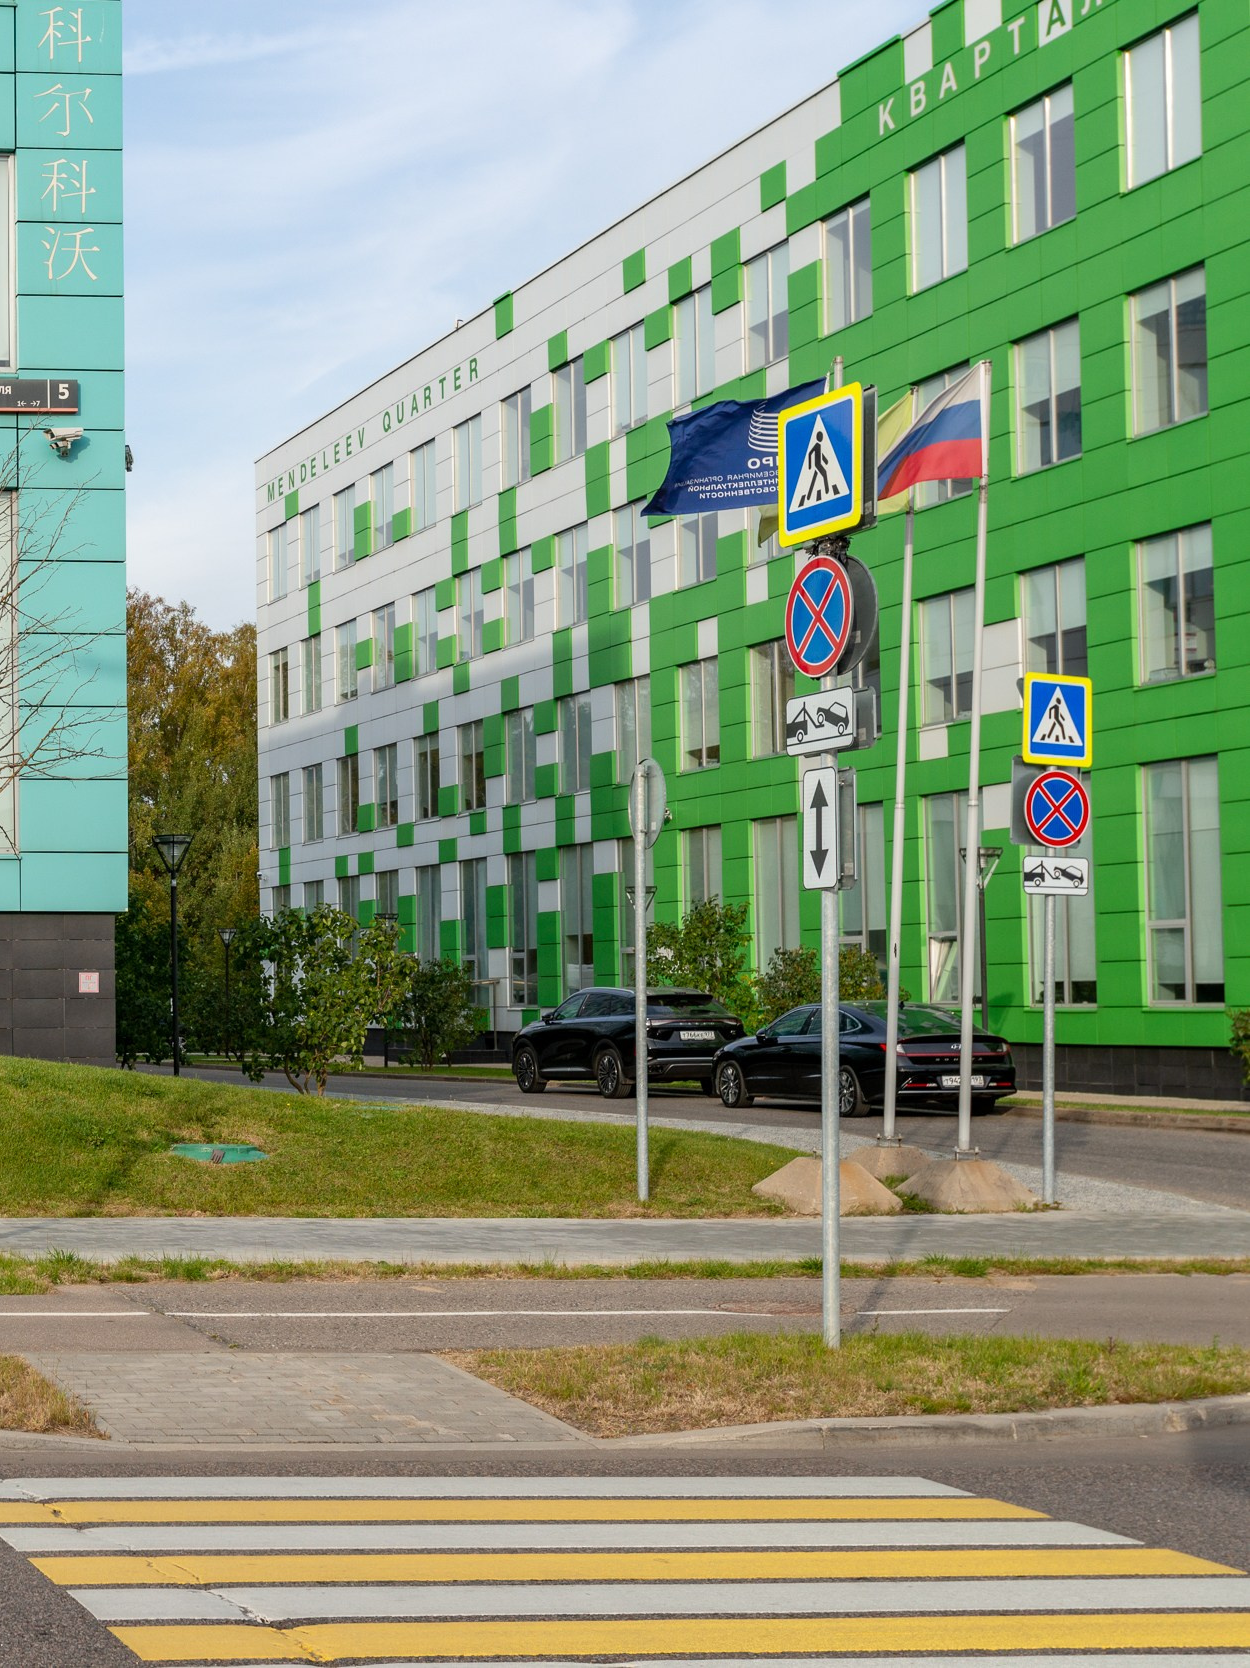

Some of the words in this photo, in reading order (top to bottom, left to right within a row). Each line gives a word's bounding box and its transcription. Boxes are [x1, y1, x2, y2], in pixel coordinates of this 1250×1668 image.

[33, 6, 100, 281] 科尔科沃
[58, 383, 70, 400] 5
[267, 427, 366, 503] MENDELEEV
[382, 357, 479, 433] QUARTER
